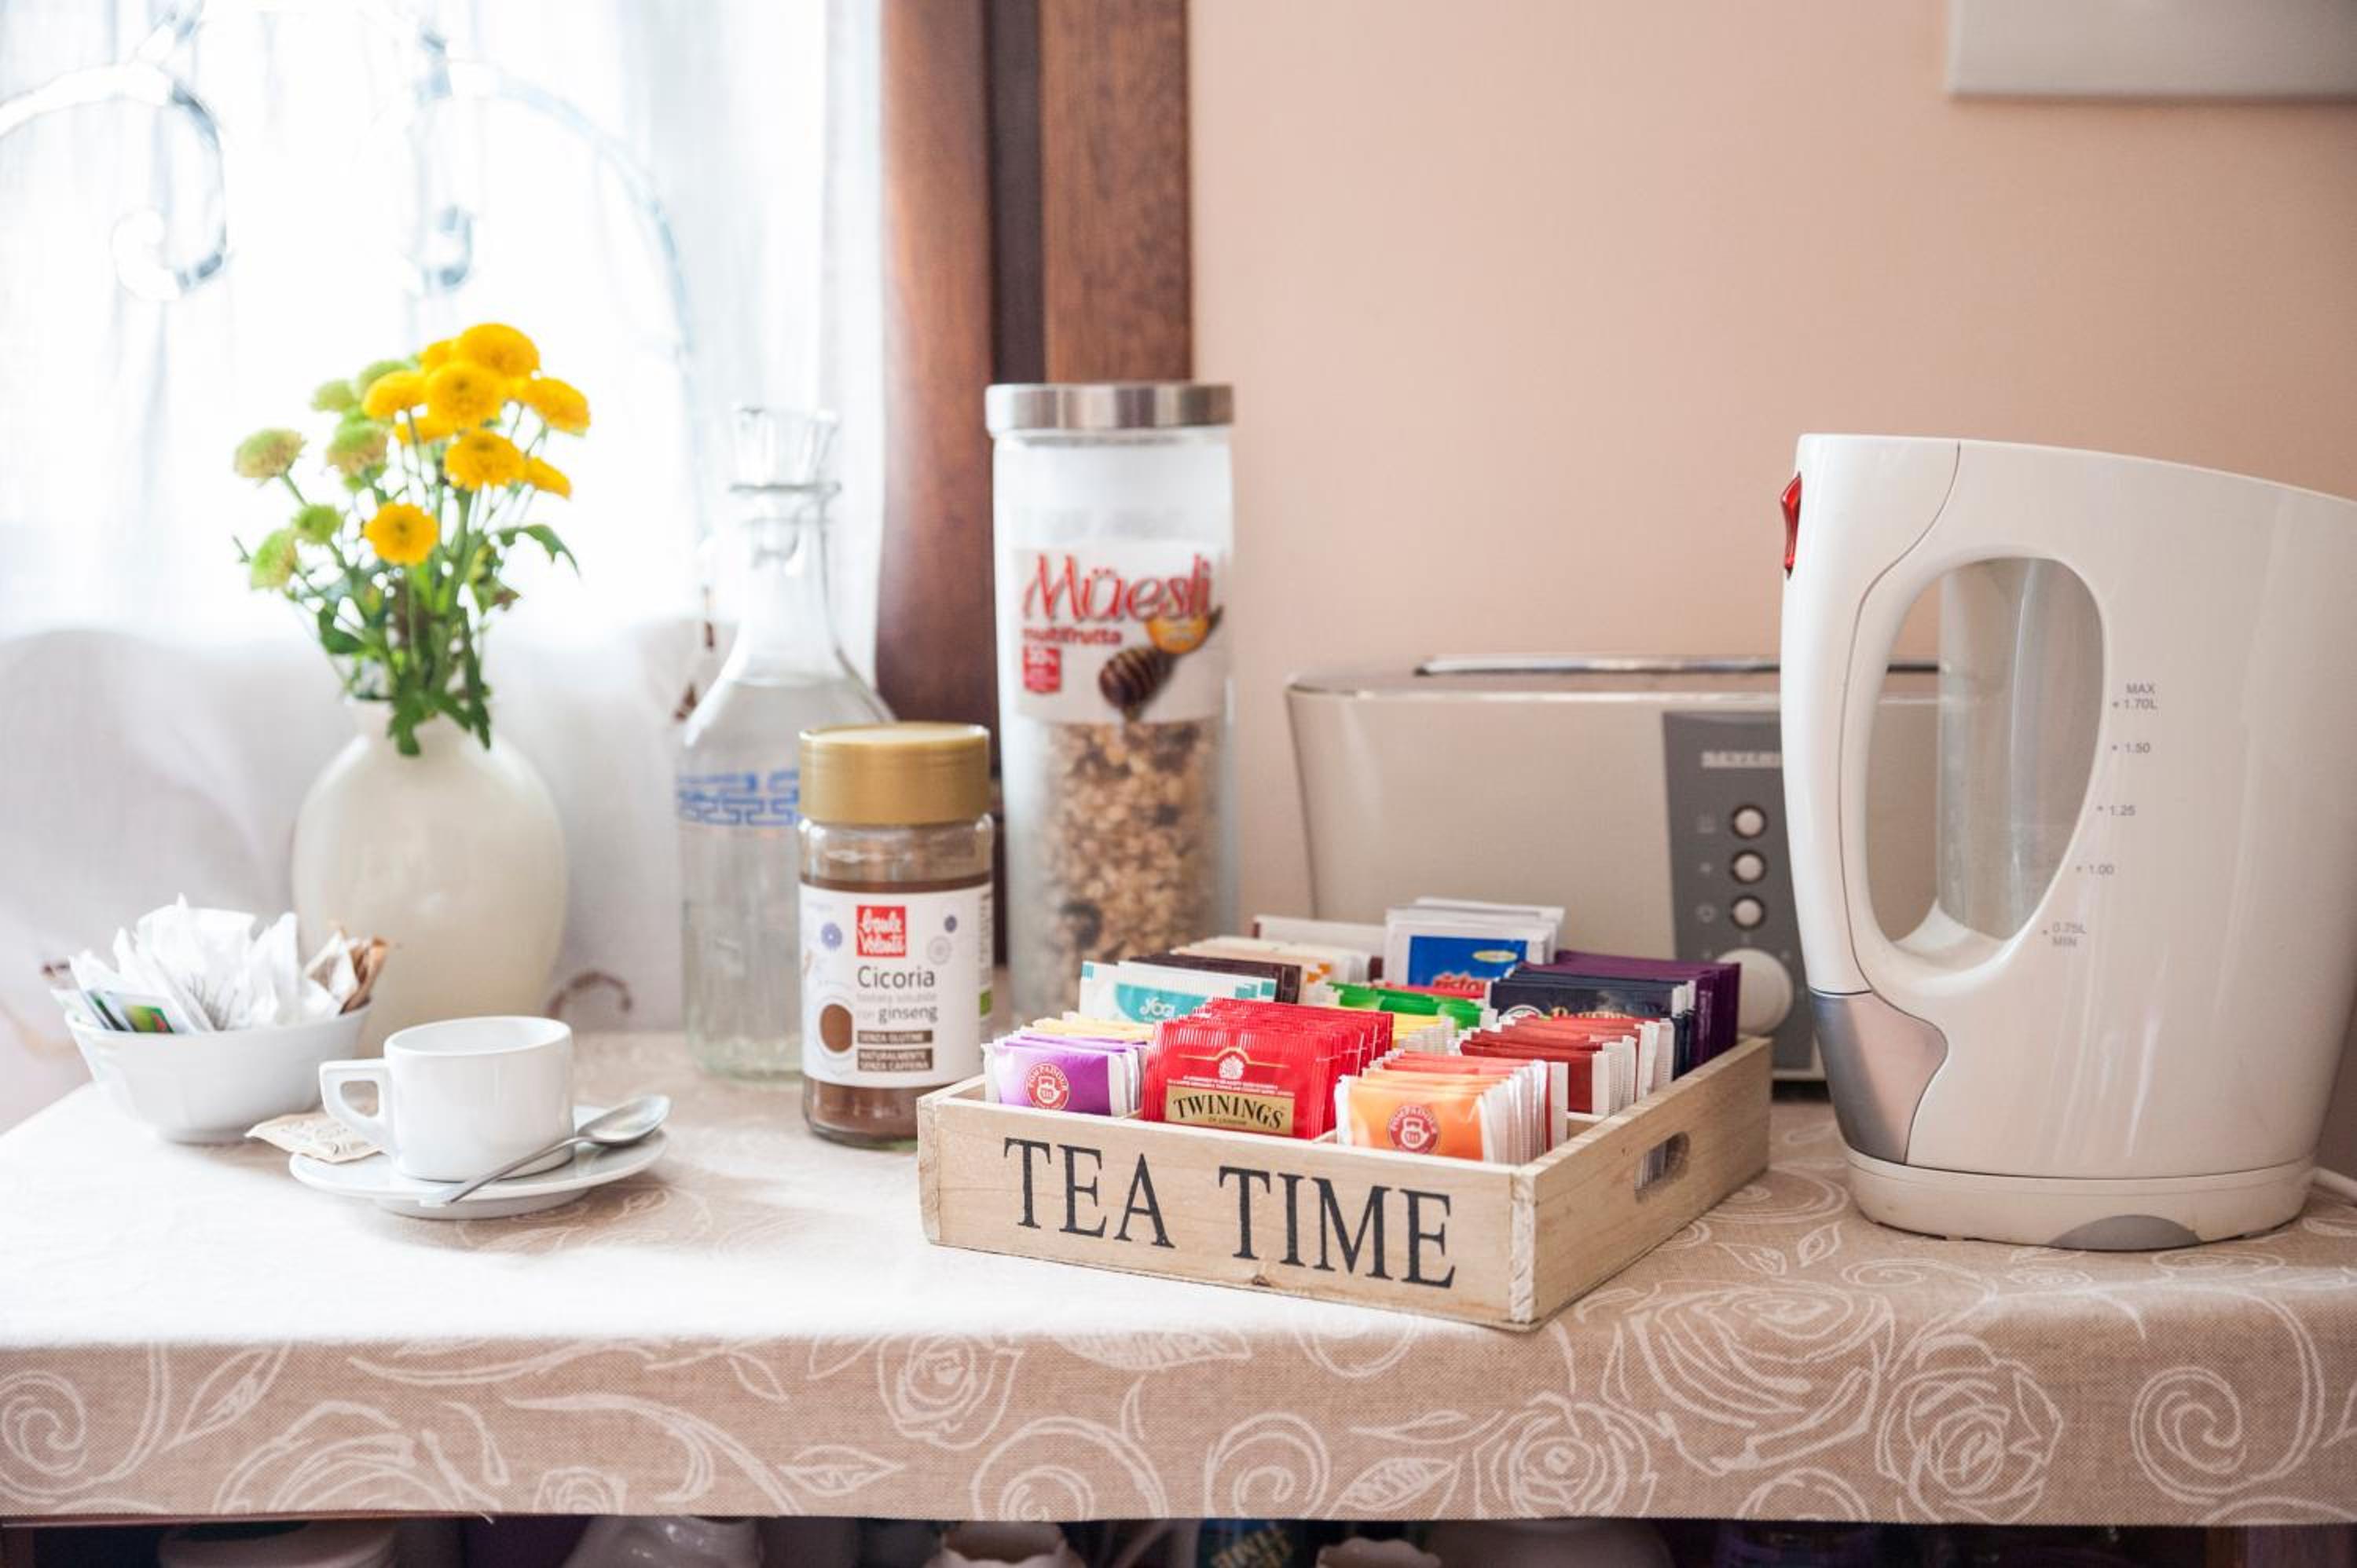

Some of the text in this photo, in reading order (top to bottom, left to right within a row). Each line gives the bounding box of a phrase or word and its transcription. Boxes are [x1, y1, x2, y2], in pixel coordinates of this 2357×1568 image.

[1022, 552, 1211, 623] Müesli
[2125, 683, 2155, 694] MAX
[2124, 698, 2158, 710] 1.70L
[2124, 742, 2151, 754] 1.50
[2110, 804, 2136, 817] 1.25
[2089, 864, 2114, 876] 1.00
[857, 965, 935, 988] Cicoria
[878, 1006, 939, 1024] ginseng
[1173, 1094, 1285, 1129] TWININGS
[1004, 1137, 1456, 1290] TEA TIME
